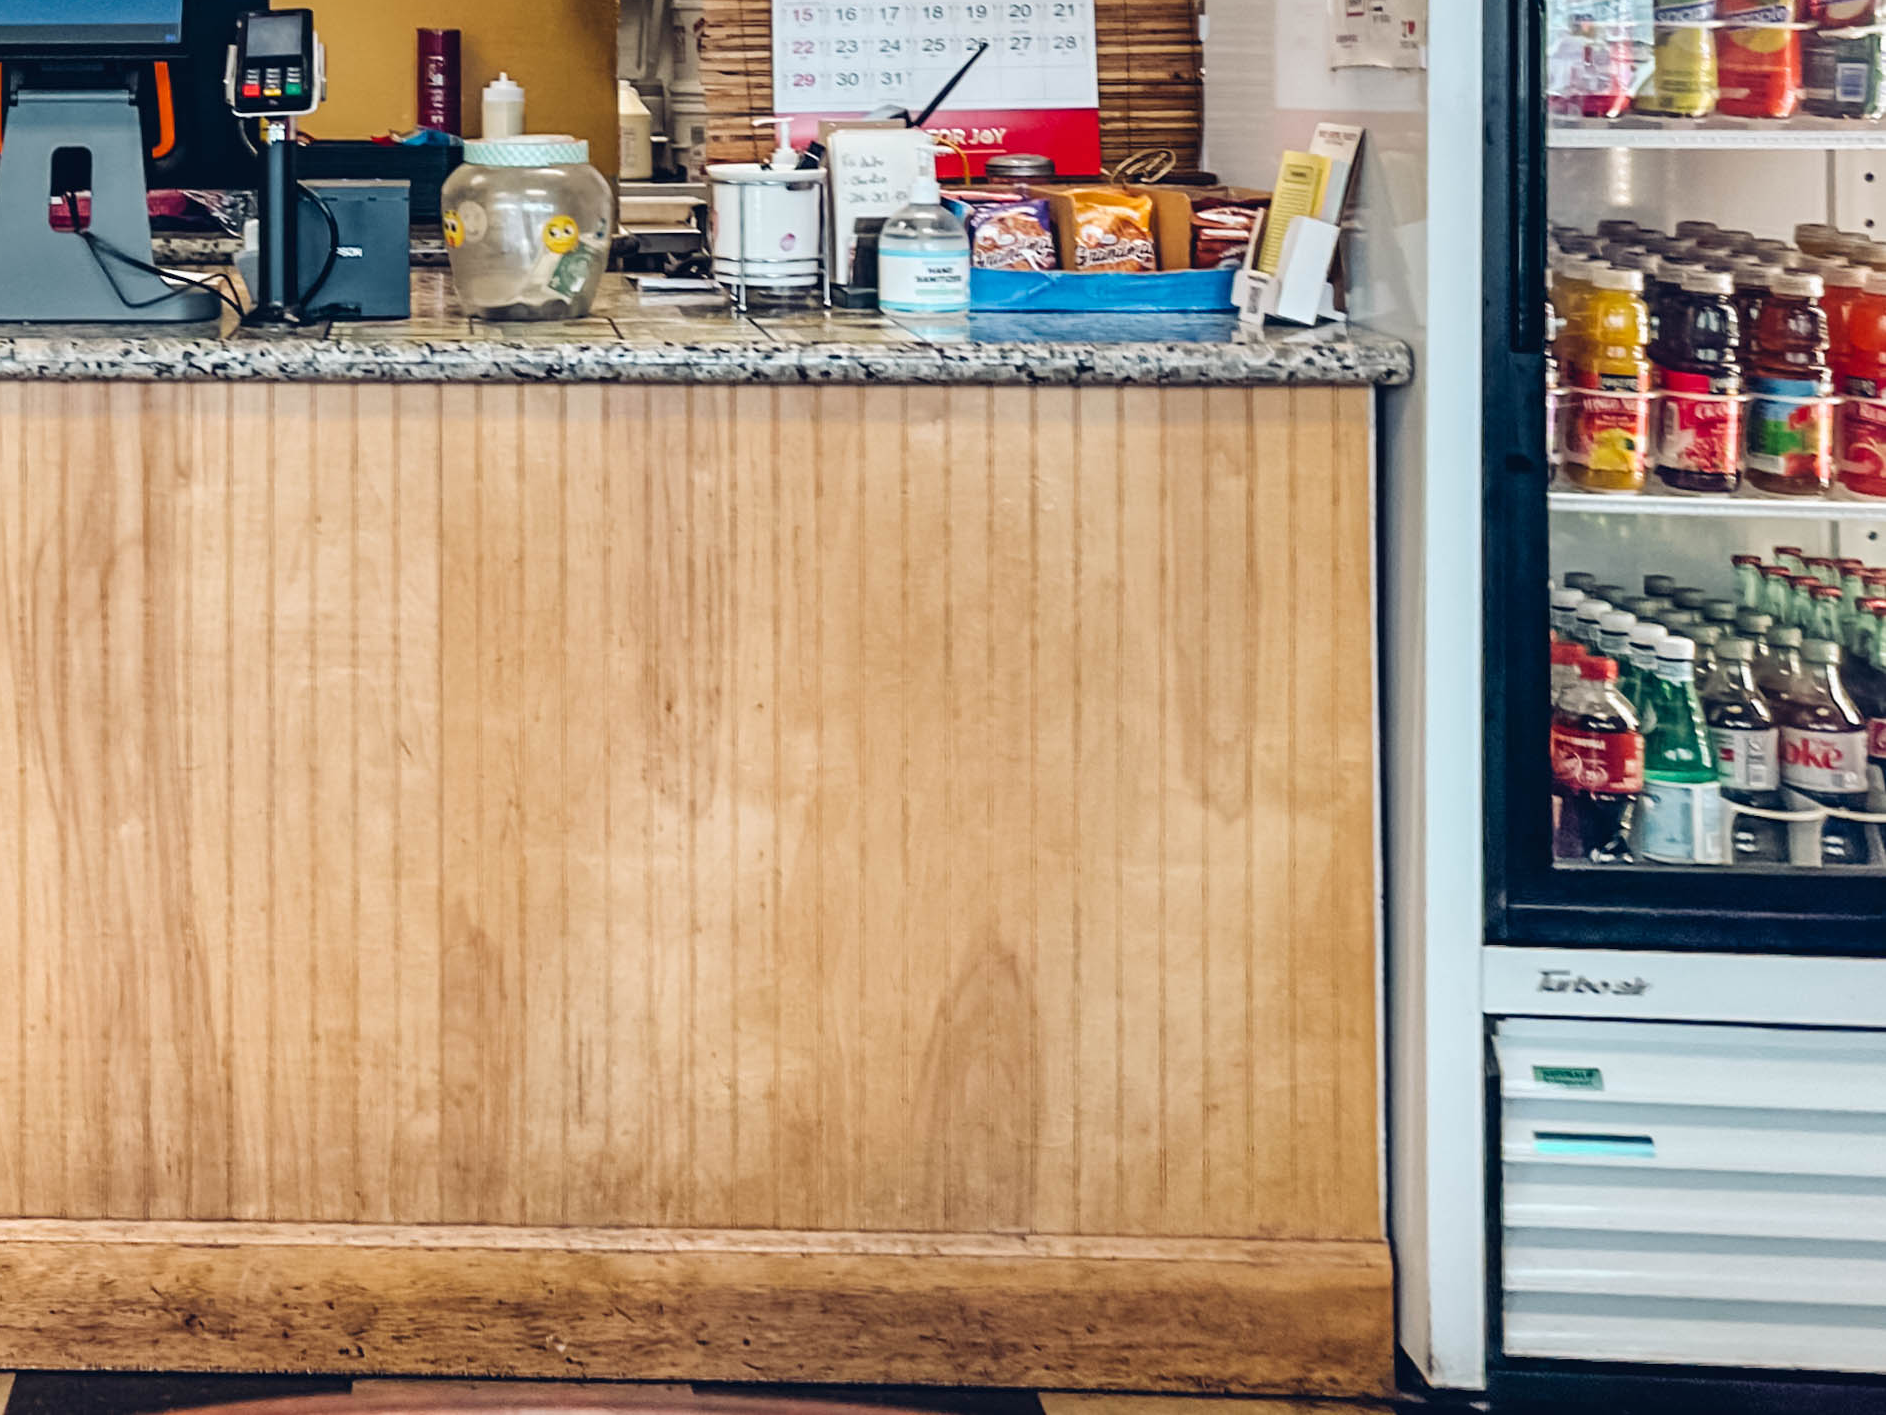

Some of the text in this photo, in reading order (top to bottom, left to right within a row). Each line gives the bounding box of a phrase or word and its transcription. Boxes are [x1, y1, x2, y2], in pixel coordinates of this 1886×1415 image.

[793, 4, 1074, 21] 15 16 17 18 19 20 21
[793, 36, 1077, 54] 22 23 24 25 26 27 28
[793, 72, 903, 87] 29 30 31
[969, 127, 1008, 145] JOY
[927, 268, 954, 276] HAND
[1785, 739, 1844, 769] oke
